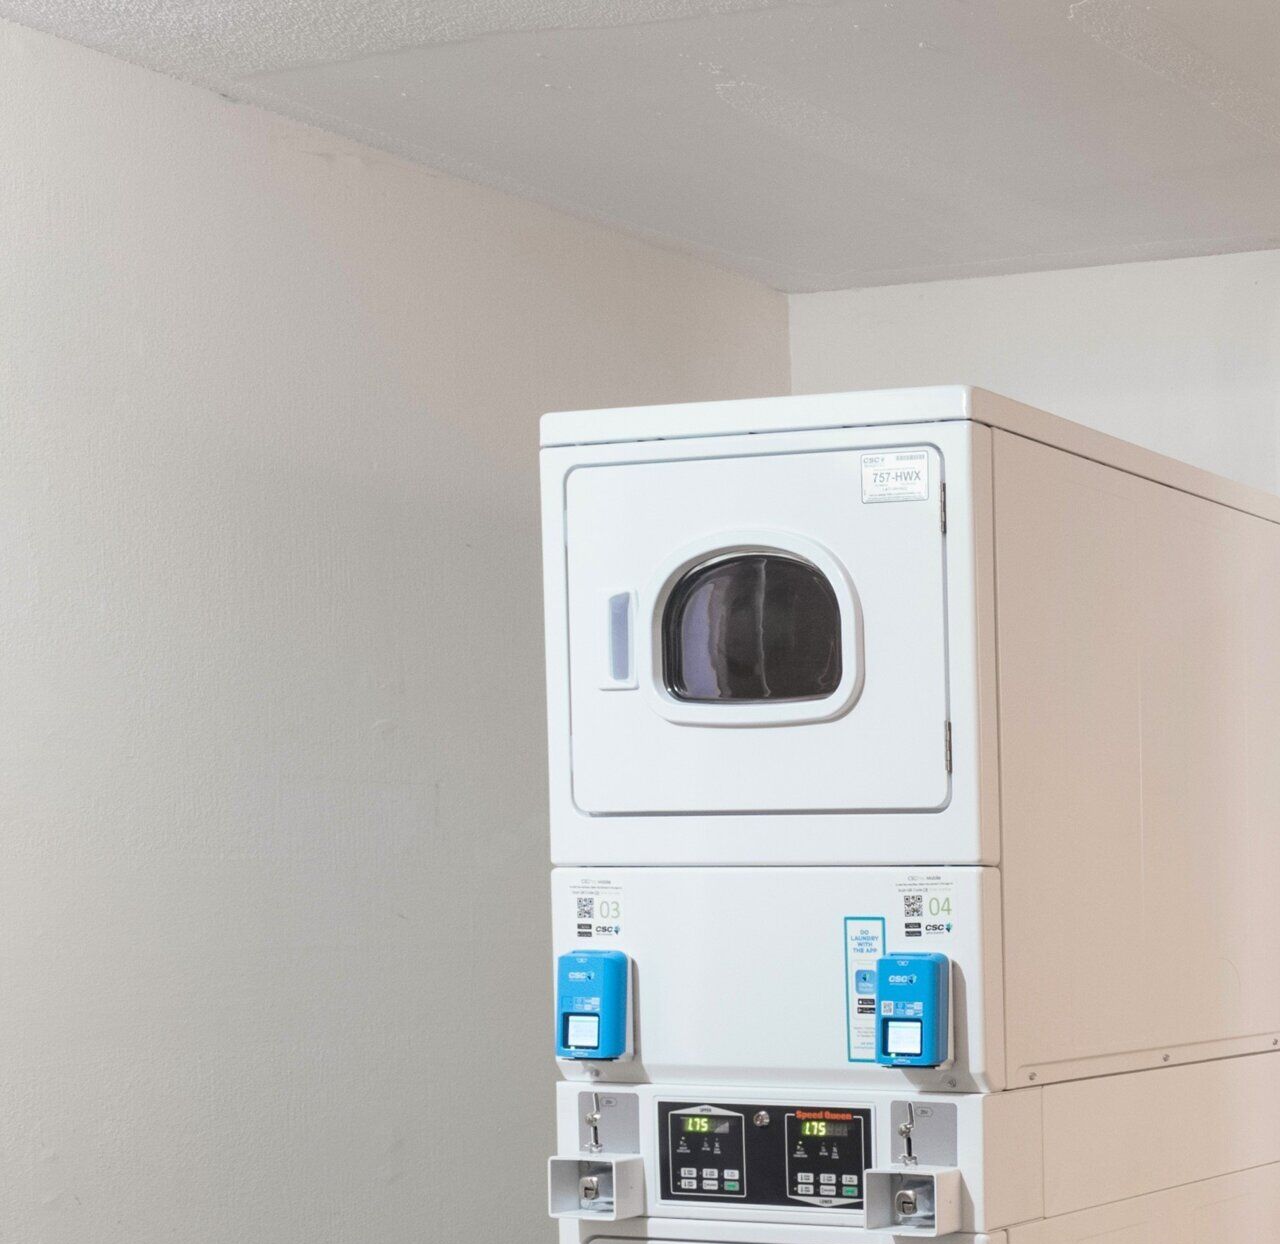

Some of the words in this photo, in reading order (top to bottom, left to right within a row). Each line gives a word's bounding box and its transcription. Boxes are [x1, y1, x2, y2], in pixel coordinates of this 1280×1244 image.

[873, 470, 921, 483] 757-HWX
[600, 901, 620, 919] 03
[929, 897, 952, 916] 04
[888, 975, 908, 983] CSC
[796, 1110, 823, 1120] Speed
[824, 1111, 852, 1120] Queen
